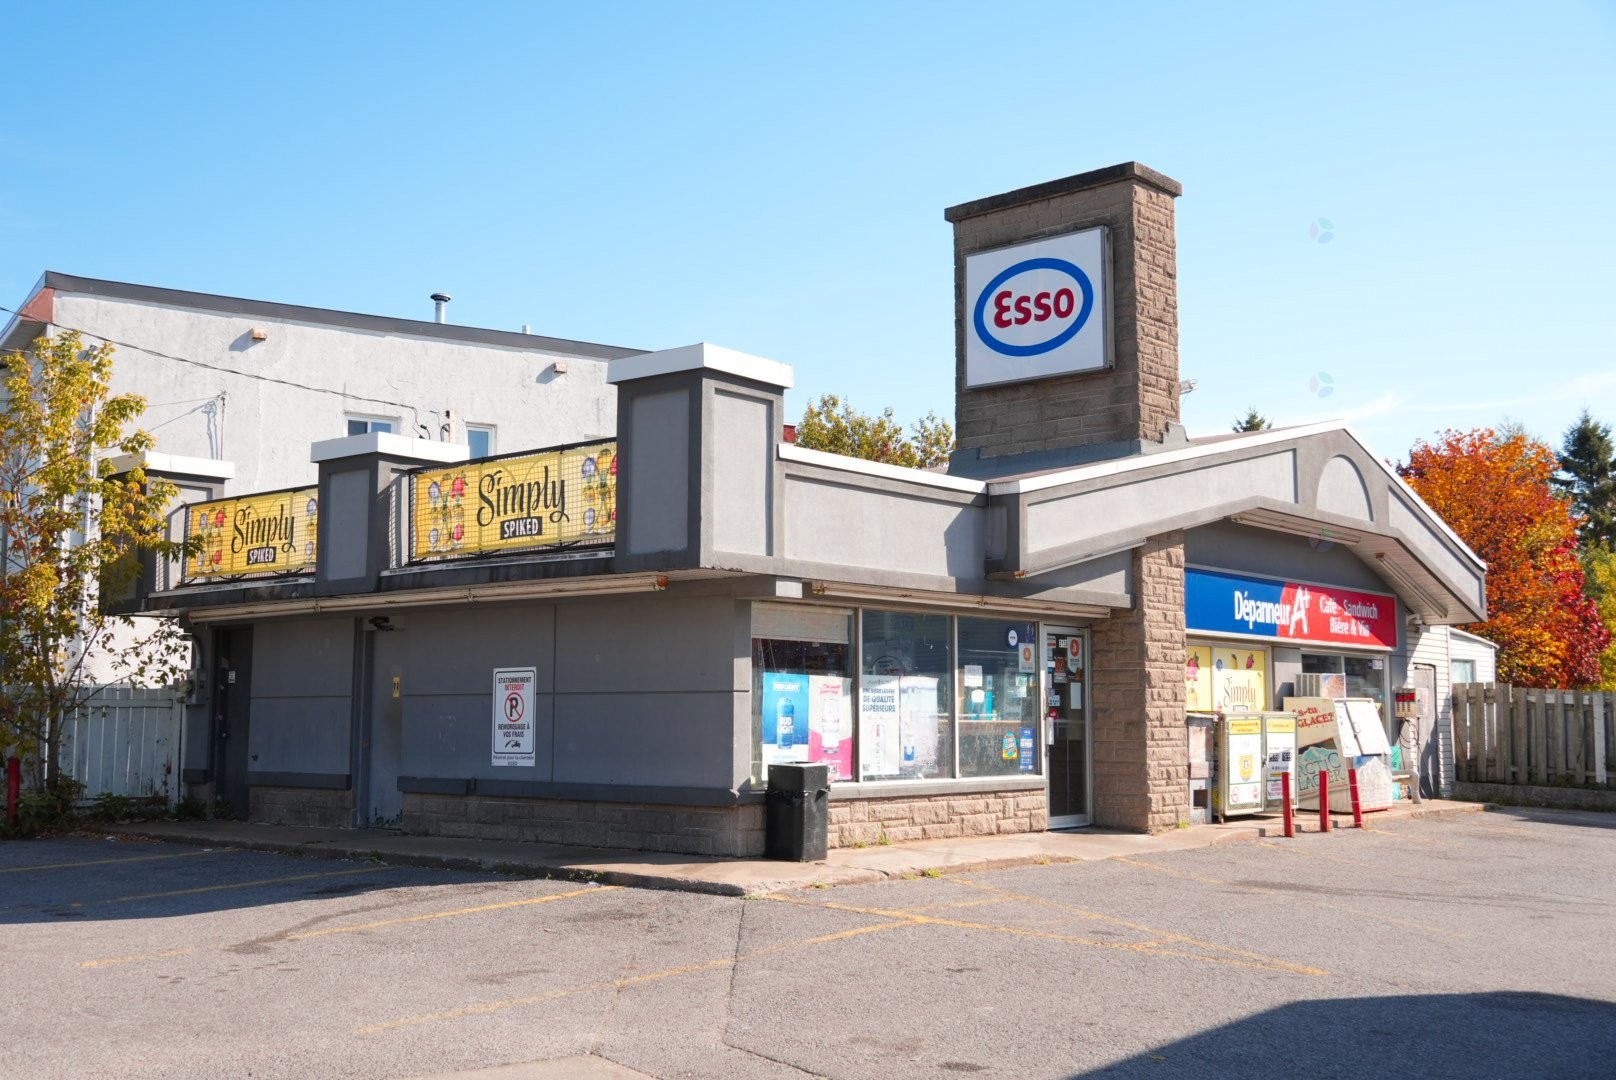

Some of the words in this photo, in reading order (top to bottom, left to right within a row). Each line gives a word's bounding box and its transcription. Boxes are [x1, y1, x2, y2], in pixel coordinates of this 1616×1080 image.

[477, 466, 570, 527] Simply
[231, 504, 296, 554] Simply
[503, 521, 539, 538] SPIKED
[249, 548, 274, 564] SPIKED
[1234, 590, 1290, 629] Dépanneur
[1319, 595, 1337, 615] Café
[1343, 599, 1379, 620] Sandwich
[1329, 616, 1349, 635] Bière
[1350, 619, 1358, 636] &
[1358, 620, 1371, 637] Vin
[498, 676, 532, 684] STATIONNEMENT
[1223, 677, 1257, 711] Simply
[1298, 752, 1342, 778] RCTIC
